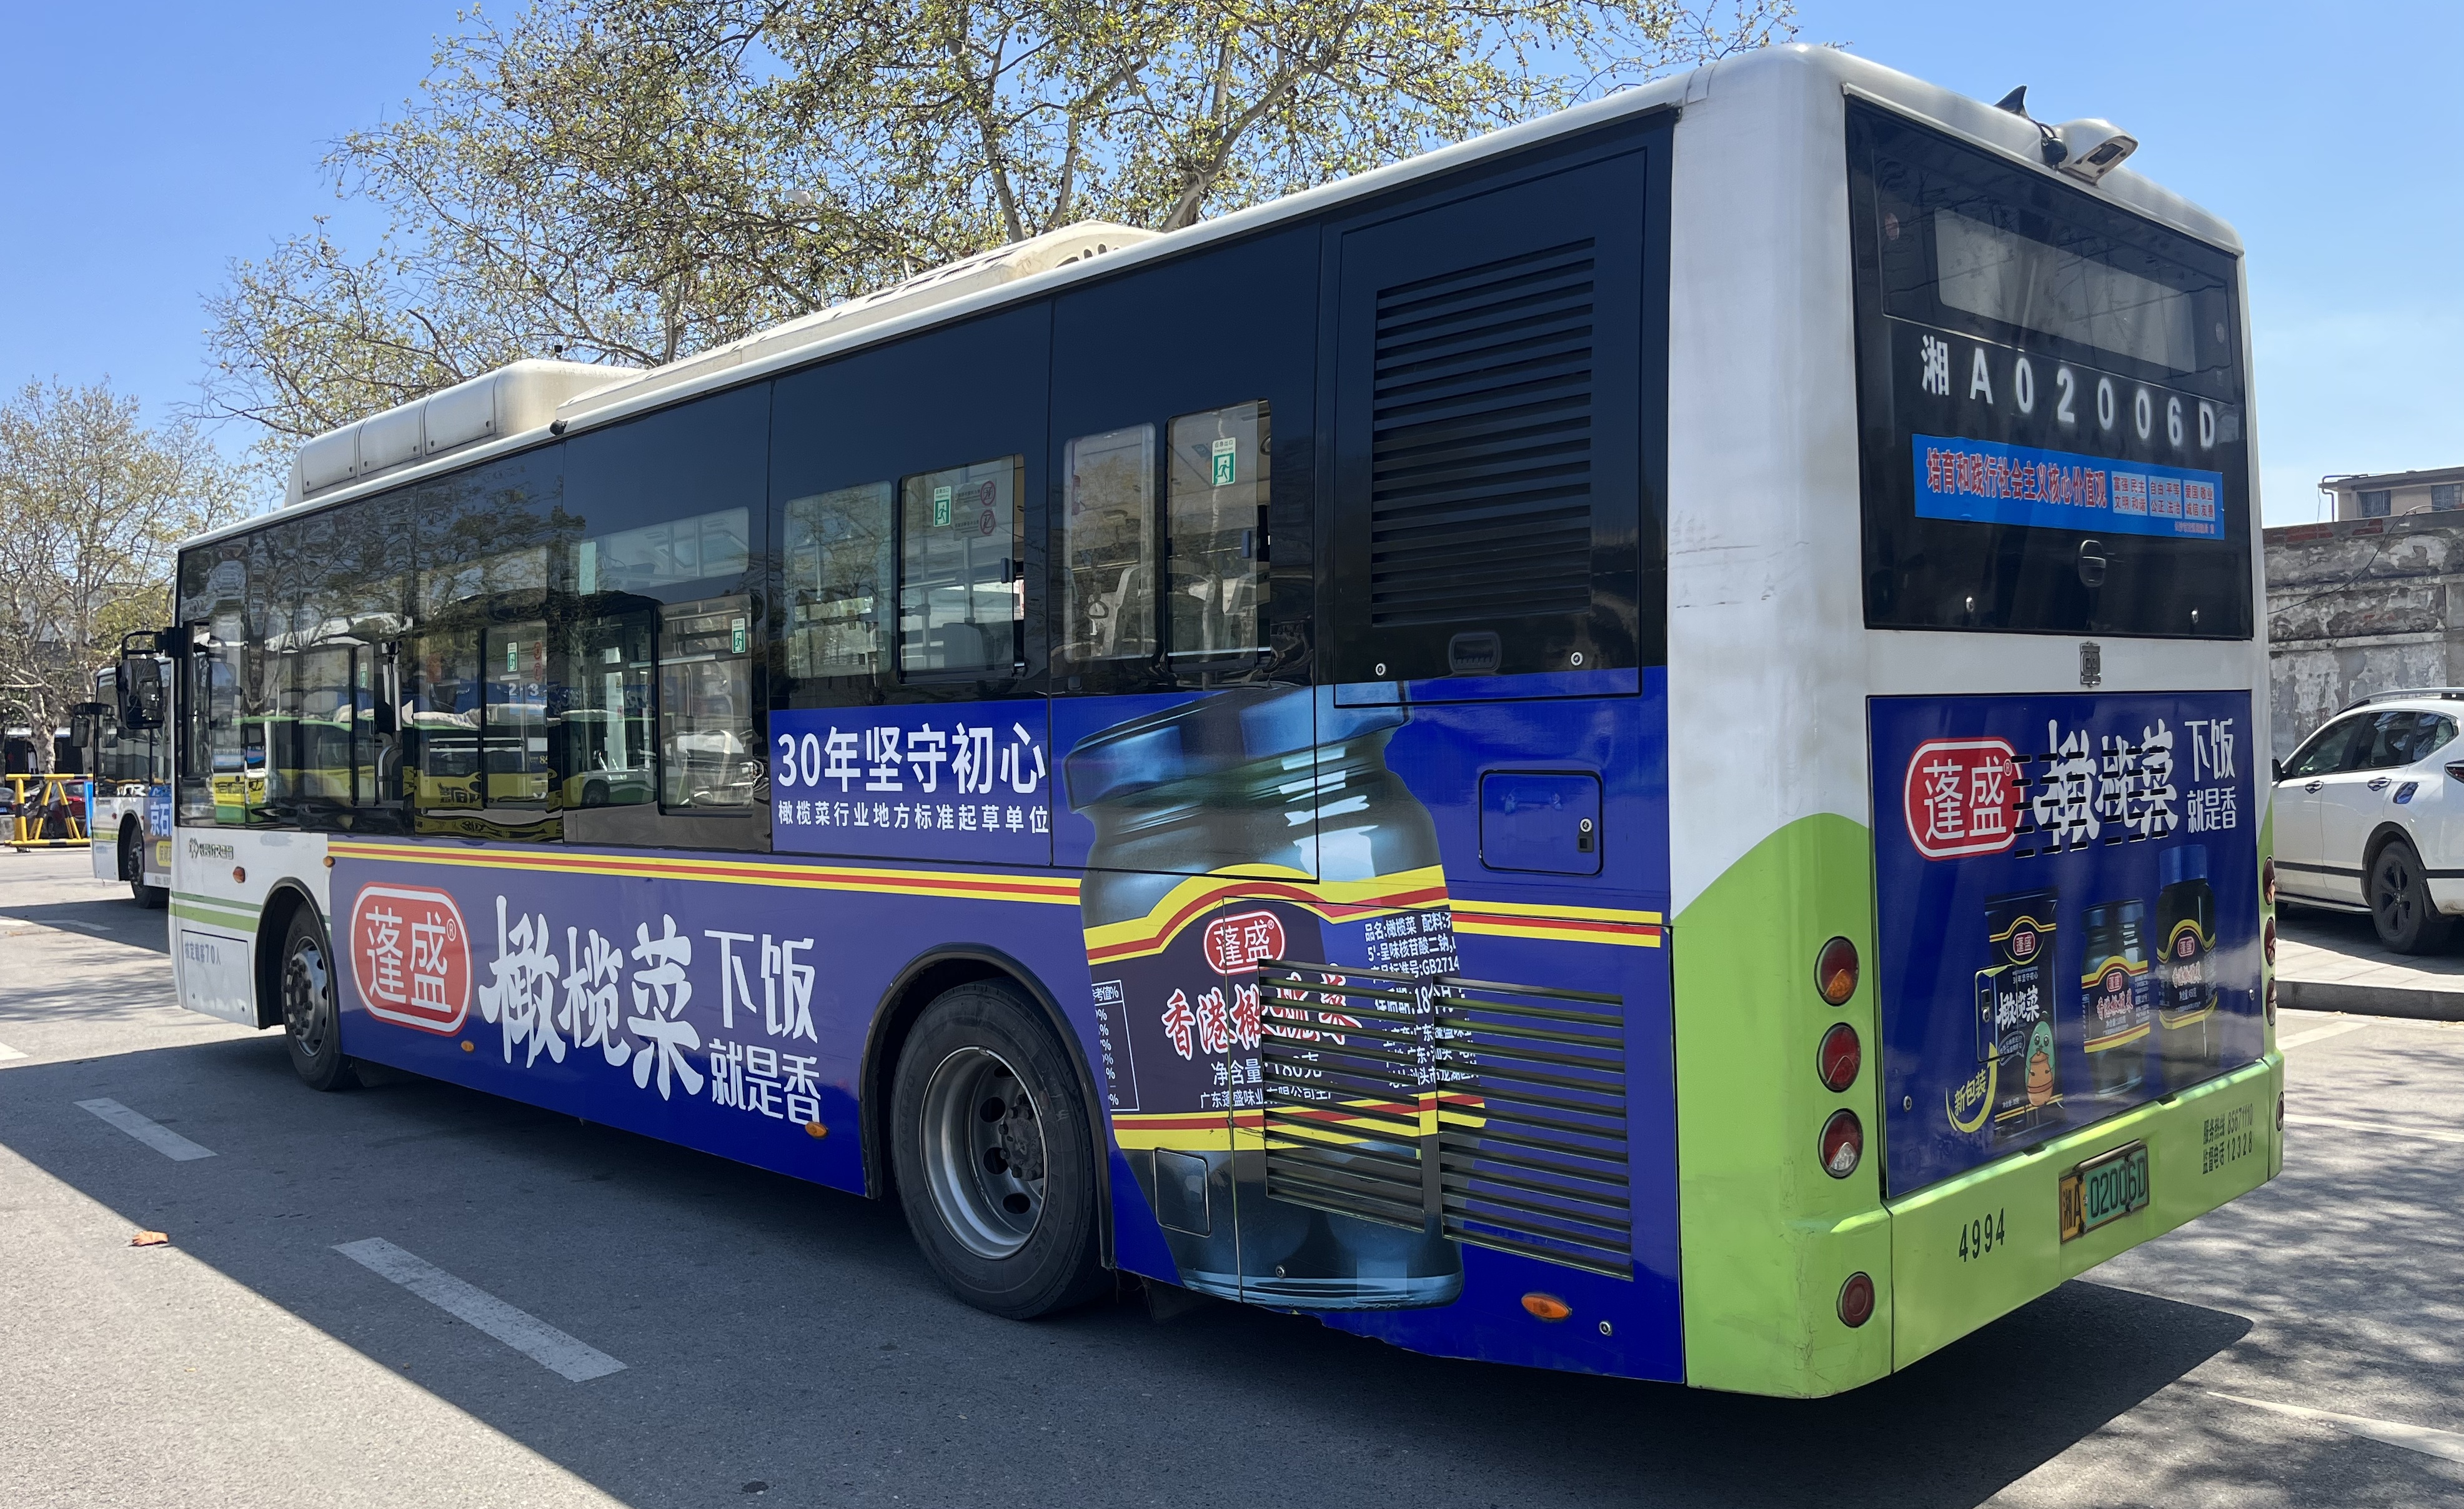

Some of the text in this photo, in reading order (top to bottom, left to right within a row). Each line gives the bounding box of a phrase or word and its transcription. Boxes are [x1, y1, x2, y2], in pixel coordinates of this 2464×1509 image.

[1920, 334, 2217, 451] 湘A02006D
[1926, 446, 2107, 509] 培育和践行社会主义核心价值观
[2113, 476, 2146, 494] 富强 民主
[2150, 481, 2180, 498] 自由 平等
[2185, 484, 2213, 501] 爱国 敬业
[2114, 494, 2147, 512] 文明 和谐
[2150, 499, 2181, 515] 公正 法治
[2185, 502, 2214, 518] 诚信 友善
[777, 722, 1047, 794] 30年坚守初心
[1922, 718, 2235, 847] 蓬盛 橄榄菜 下饭
[150, 801, 172, 837] 京石
[777, 800, 1050, 834] 橄榄菜行业地方标准起草单位
[2187, 785, 2237, 834] 就是香
[1212, 920, 1273, 965] 蓬盛
[1364, 915, 1418, 942] 品名:橄榄菜
[364, 894, 820, 1102] 蓬盛 橄榄菜 下饭
[1996, 984, 2040, 1031] 橄榄菜
[710, 1038, 822, 1127] 就是香
[1954, 1068, 1987, 1117] 新包装
[2202, 1130, 2253, 1175] 监督电话 12328
[1958, 1207, 2006, 1263] 4994
